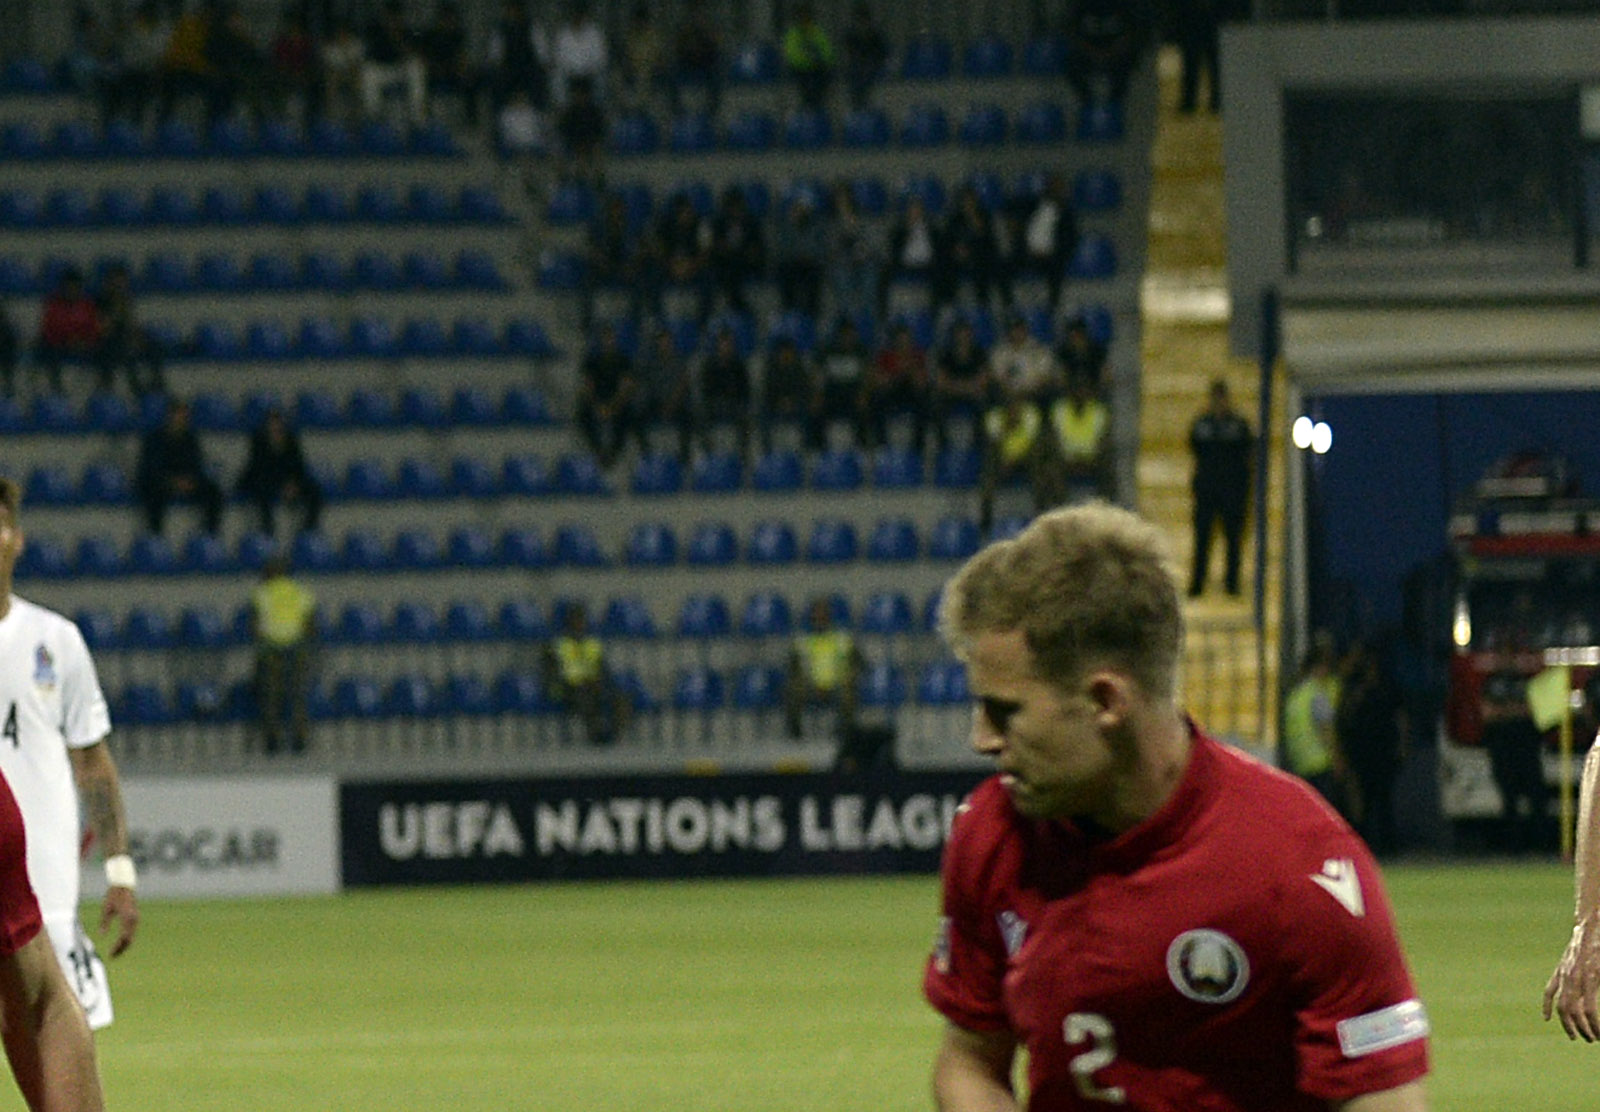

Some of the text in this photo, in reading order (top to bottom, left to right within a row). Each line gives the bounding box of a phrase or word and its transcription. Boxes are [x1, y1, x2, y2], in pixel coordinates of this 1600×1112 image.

[379, 801, 523, 858] UEFA
[534, 798, 784, 854] NATIONS
[1062, 1012, 1127, 1106] 2
